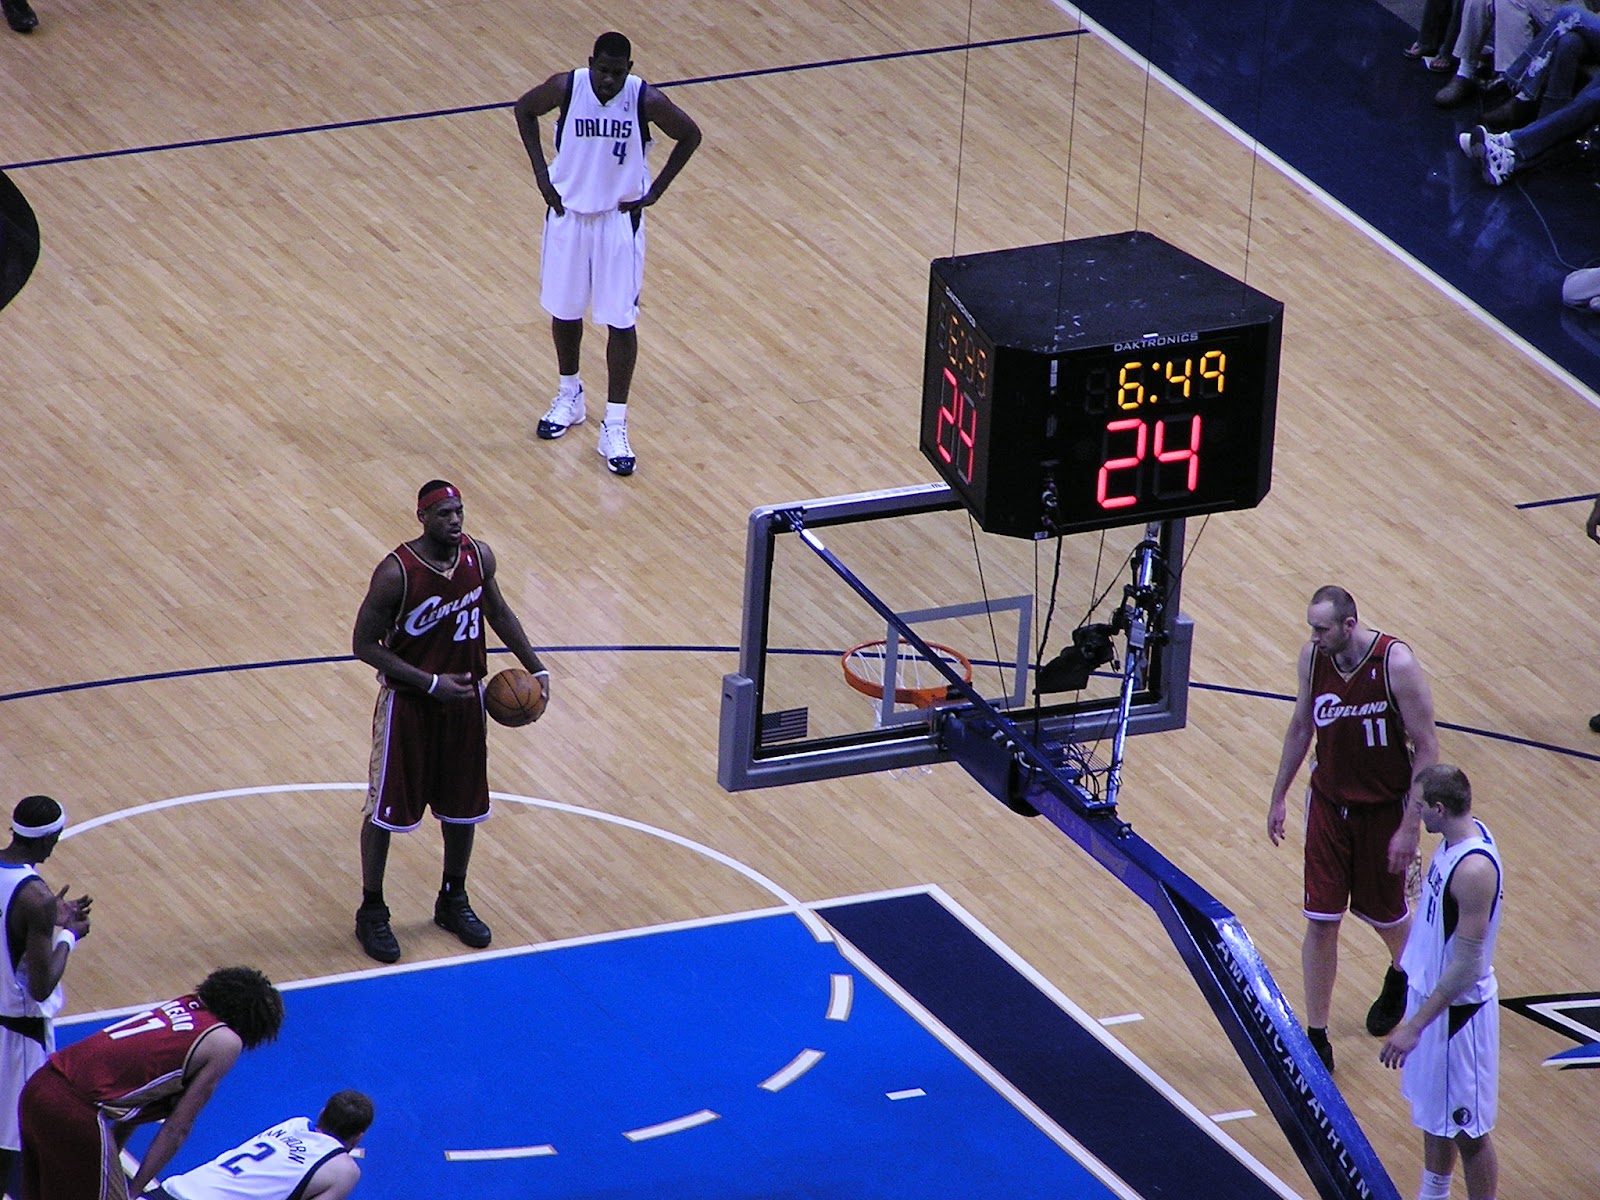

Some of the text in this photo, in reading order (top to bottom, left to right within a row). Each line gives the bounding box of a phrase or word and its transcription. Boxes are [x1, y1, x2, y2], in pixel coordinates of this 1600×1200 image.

[575, 118, 632, 139] DALLAS
[612, 141, 627, 165] 4
[1113, 332, 1199, 352] DAKTRONICS
[1117, 350, 1226, 411] 6:49
[936, 367, 977, 484] 24
[1097, 414, 1202, 510] 24
[404, 586, 482, 636] CLEVELAND
[453, 607, 480, 641] 23
[1313, 693, 1388, 727] CLEVELAND
[1362, 717, 1389, 747] 11
[102, 1011, 167, 1040] 17
[1216, 941, 1308, 1095] AMERICAN
[219, 1141, 277, 1176] 2
